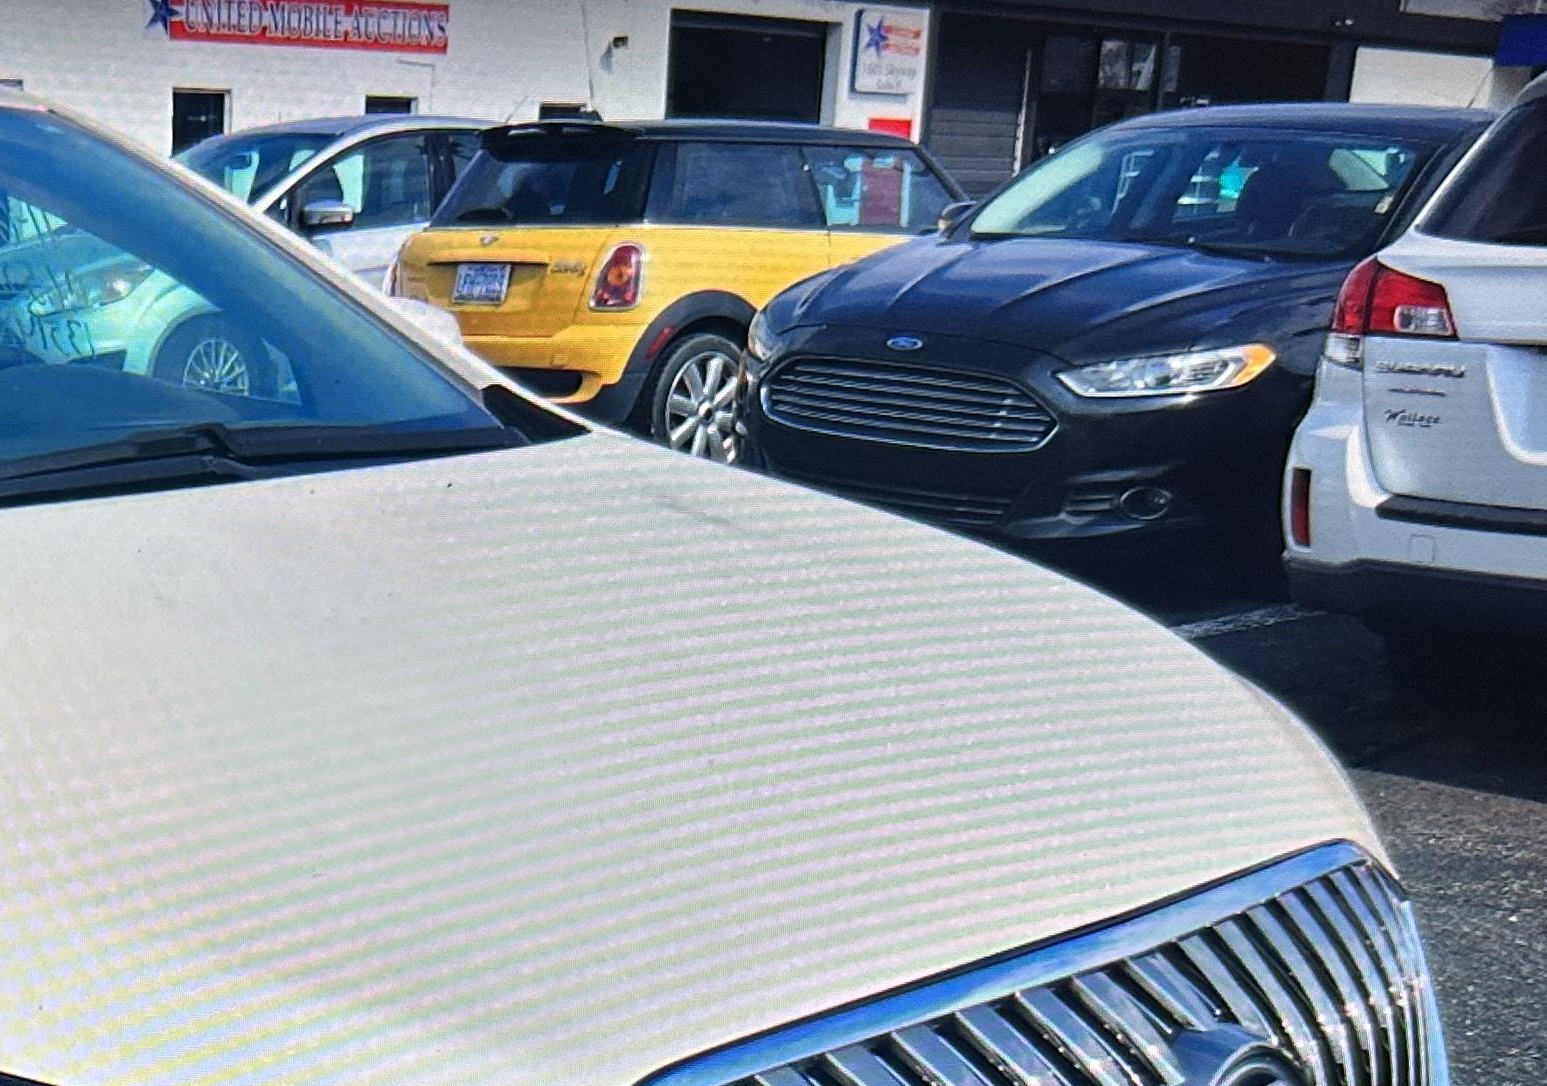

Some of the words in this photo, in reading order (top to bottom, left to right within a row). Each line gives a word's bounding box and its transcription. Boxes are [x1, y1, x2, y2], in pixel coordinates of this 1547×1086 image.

[184, 0, 262, 33] UNITED
[267, 3, 343, 39] MOBILE
[351, 6, 447, 46] AUCTIONS
